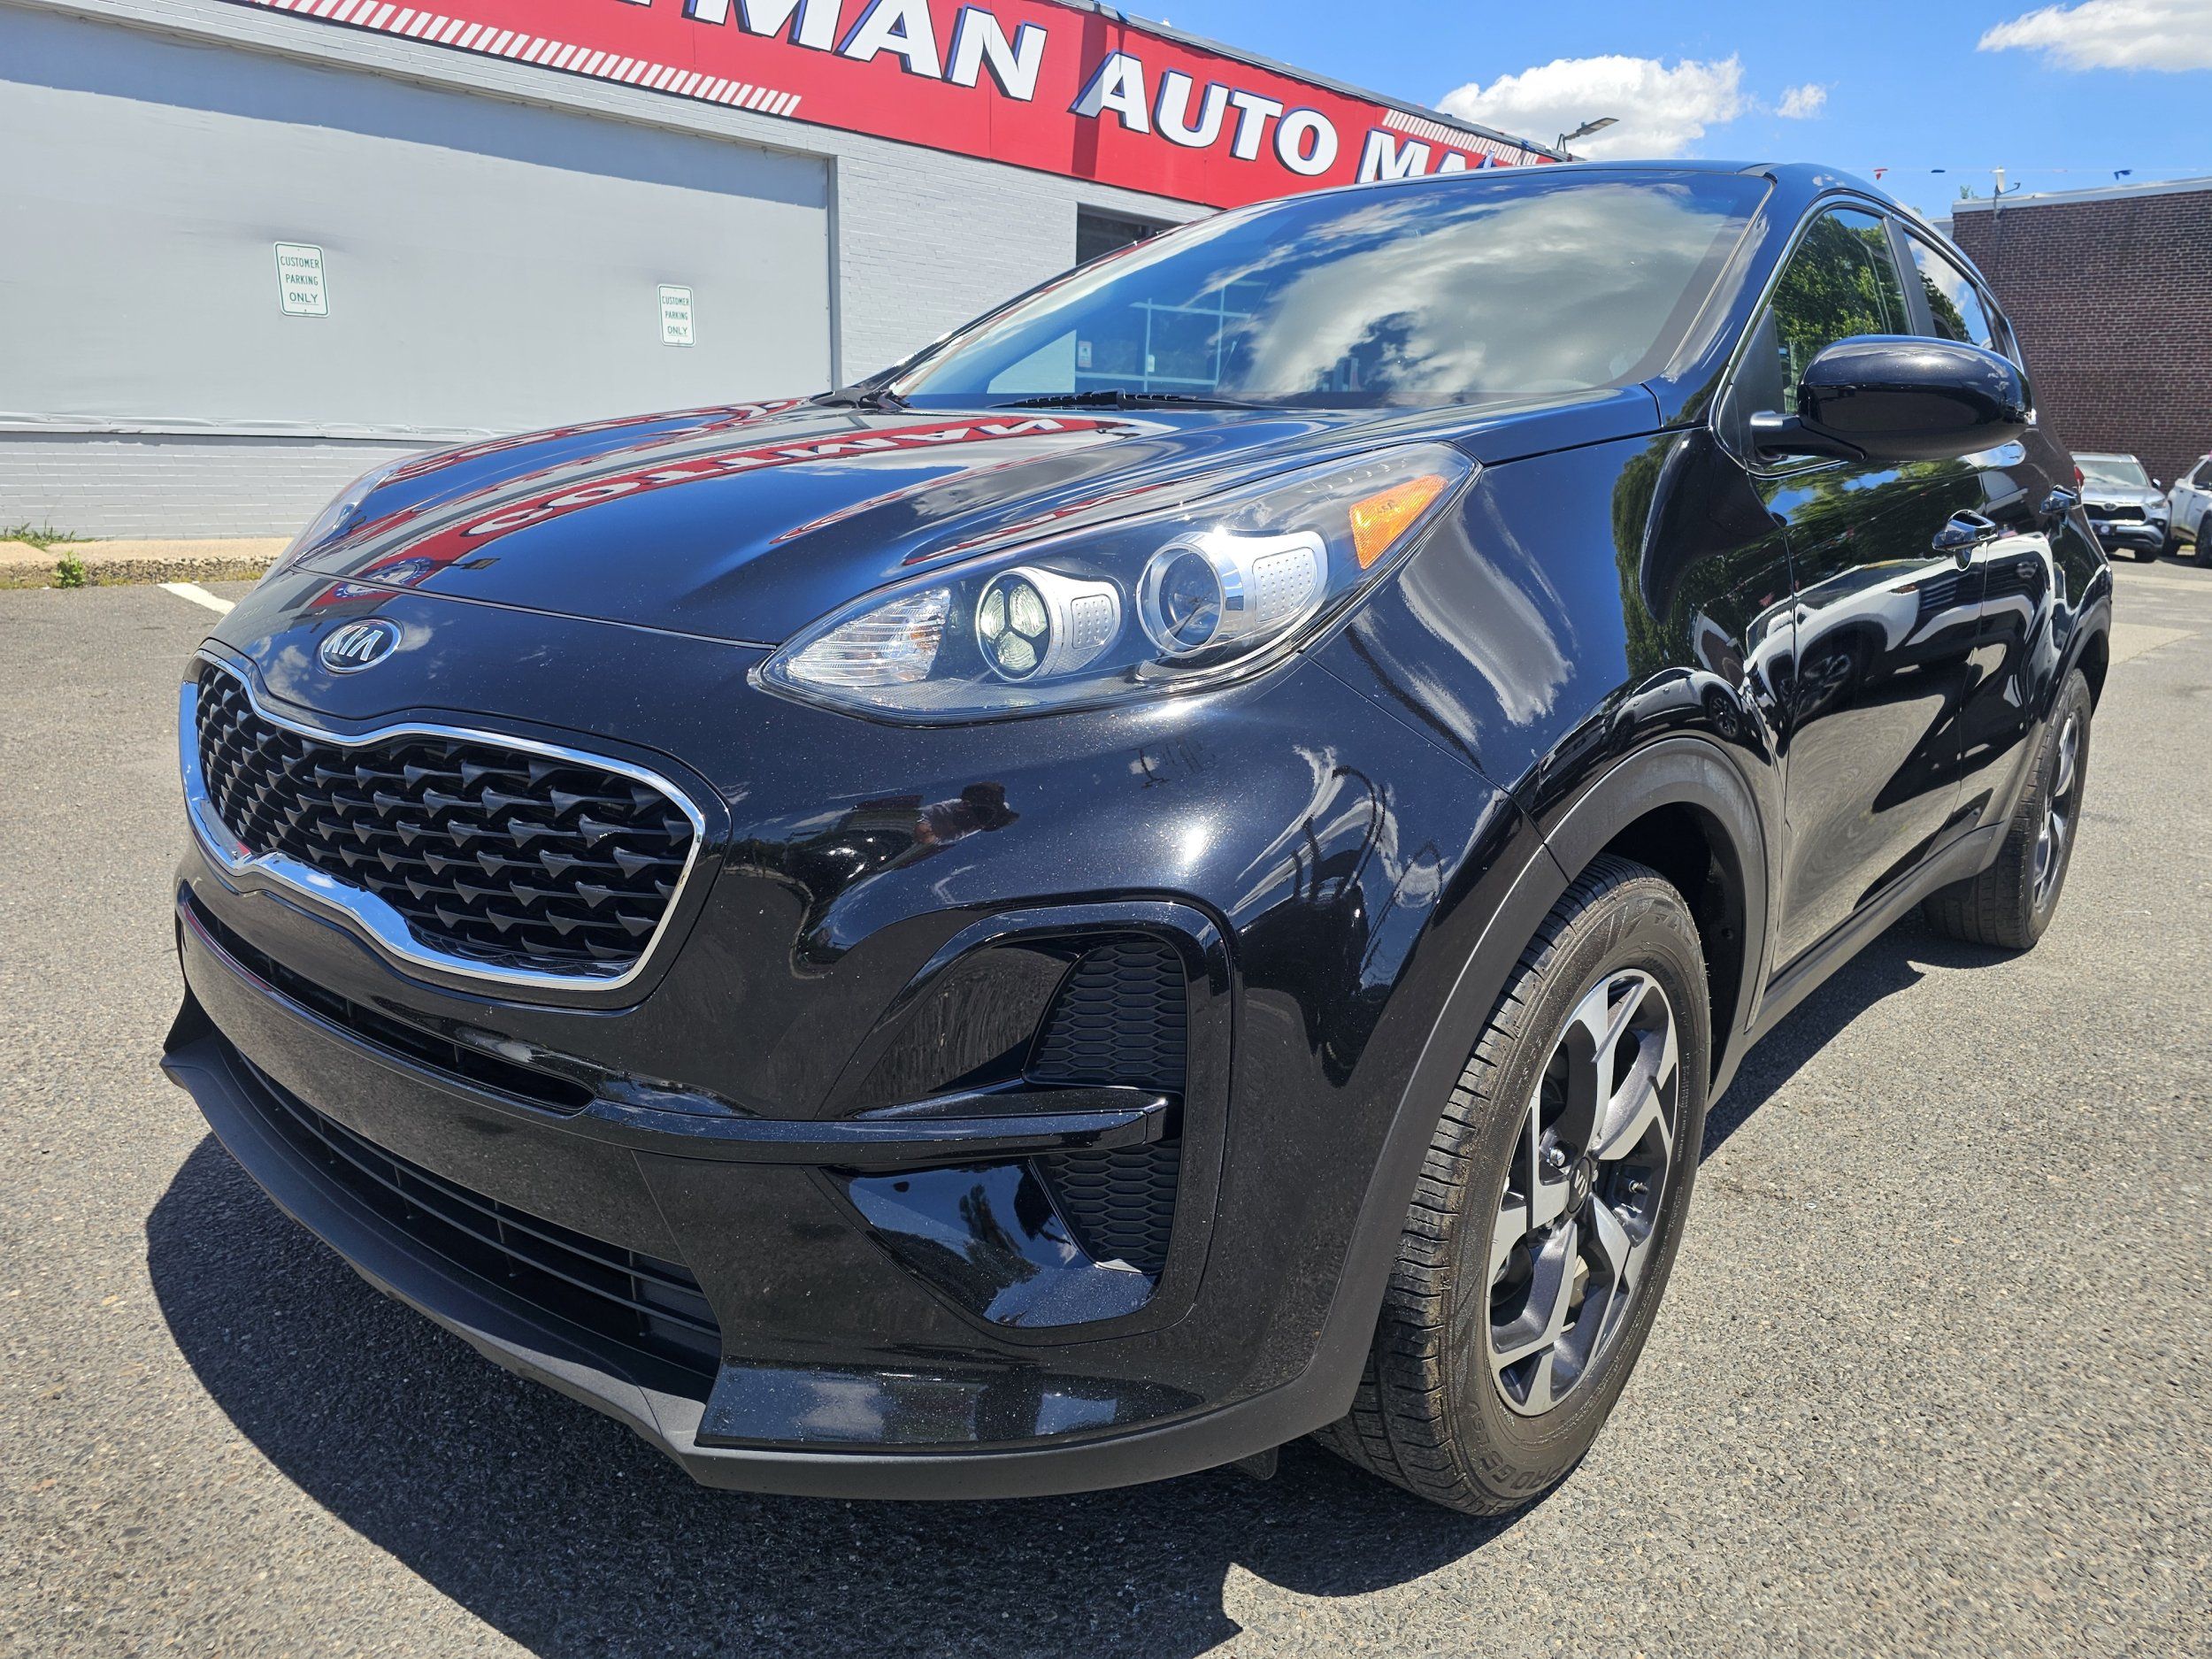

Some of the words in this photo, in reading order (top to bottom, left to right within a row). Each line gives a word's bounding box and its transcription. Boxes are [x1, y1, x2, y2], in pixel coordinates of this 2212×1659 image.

[1068, 49, 1339, 176] AUTO
[280, 256, 320, 269] CUSTOMER
[285, 273, 319, 286] PARKING
[288, 292, 319, 303] ONLY
[662, 296, 689, 306] CUSTOMER
[664, 311, 688, 320] PARKING
[667, 326, 687, 335] ONLY
[324, 625, 384, 662] KIA
